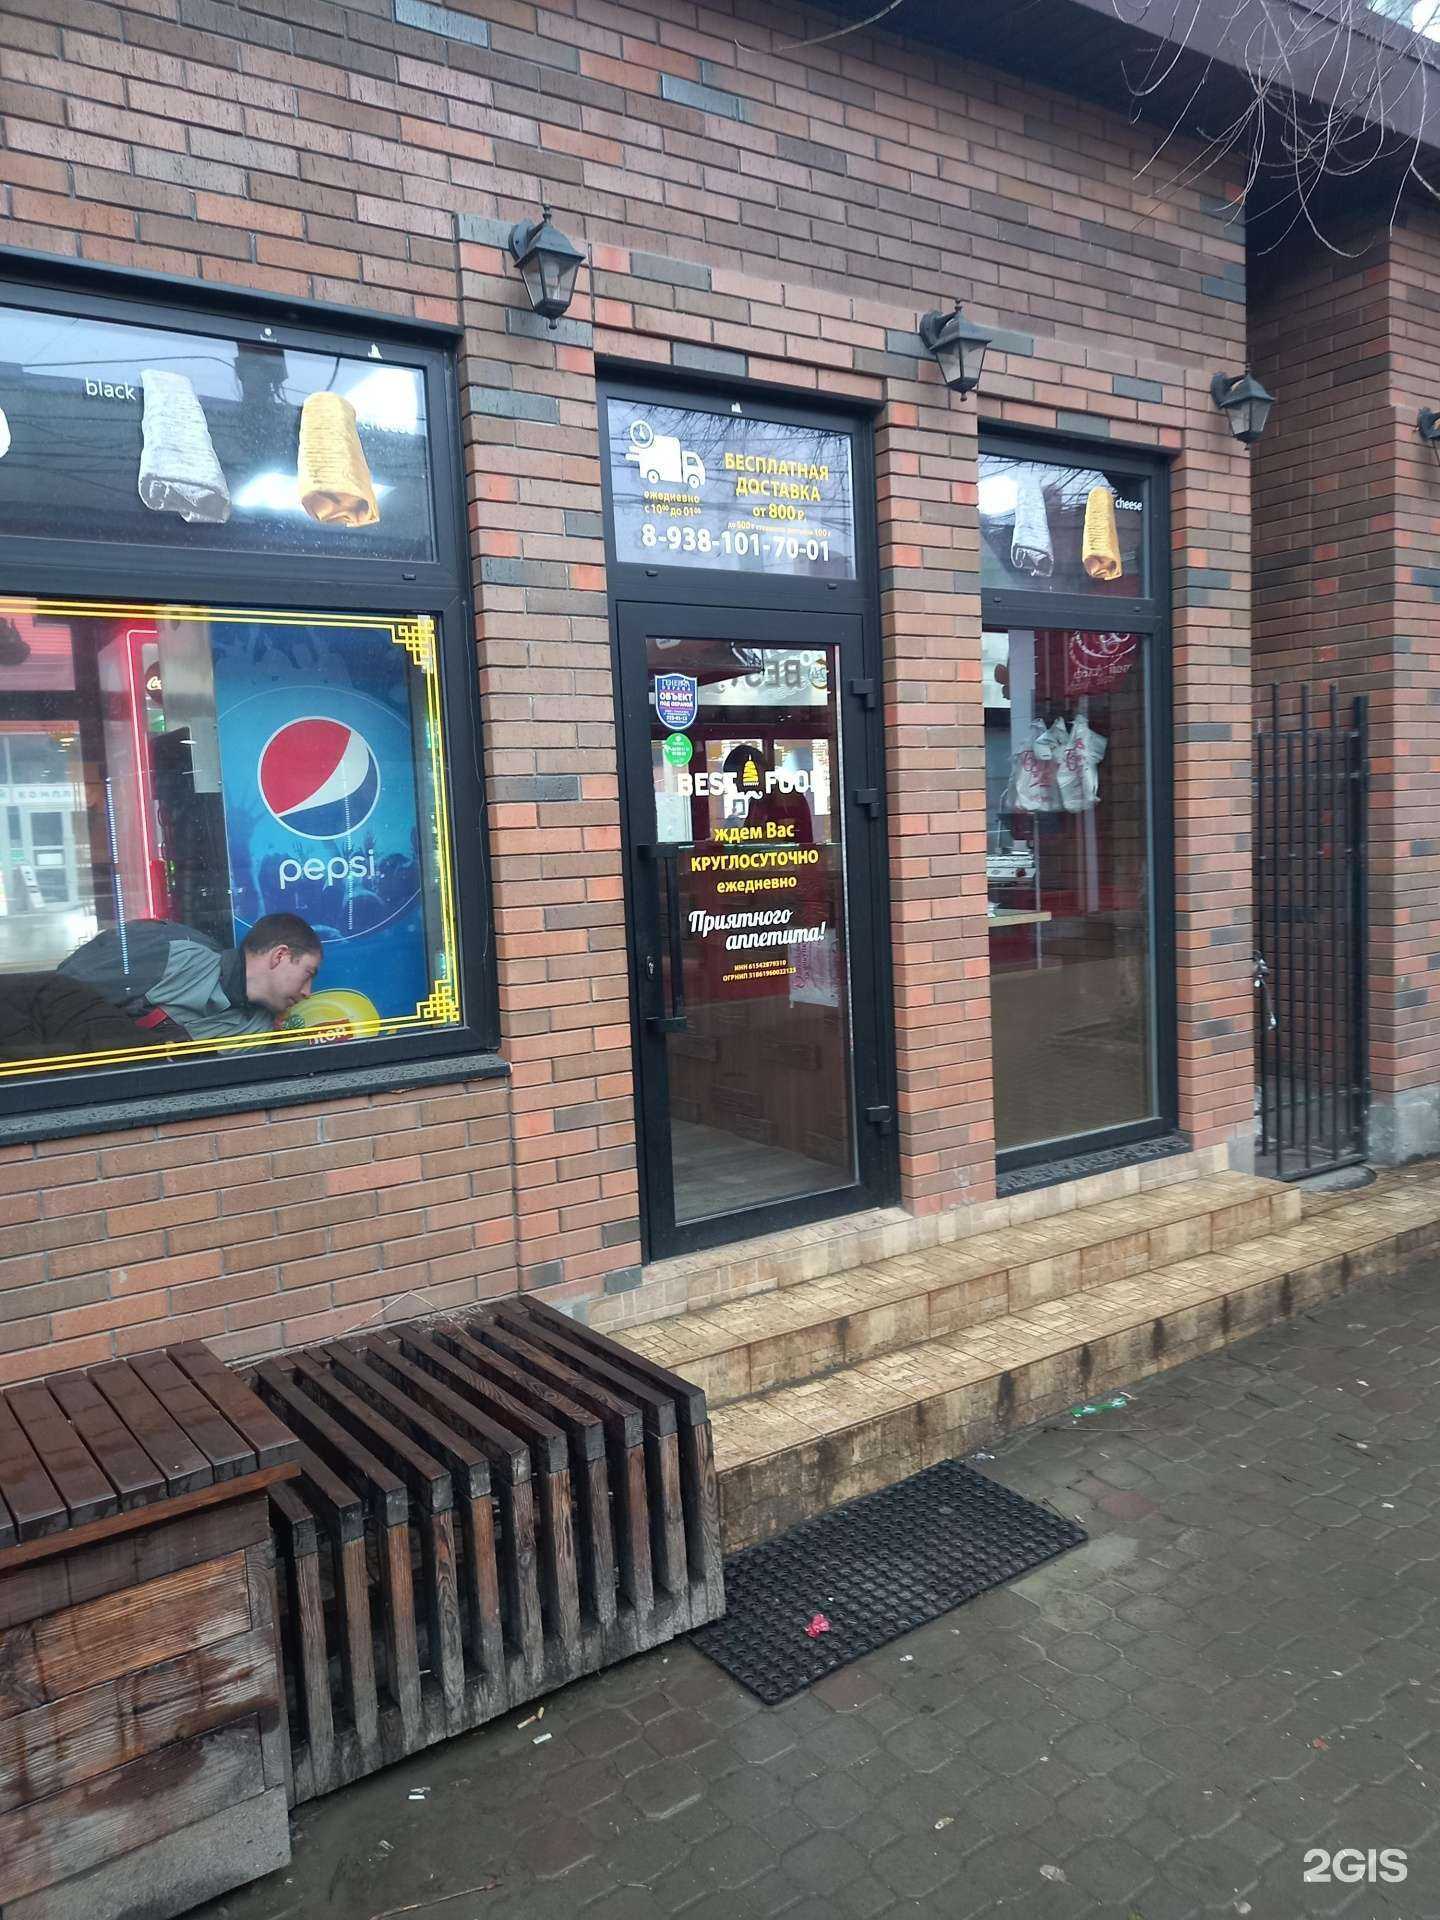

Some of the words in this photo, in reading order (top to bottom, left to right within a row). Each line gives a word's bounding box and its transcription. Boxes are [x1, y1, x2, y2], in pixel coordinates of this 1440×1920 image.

[85, 377, 136, 400] black
[725, 453, 829, 480] БЕСПЛАТНАЯ
[644, 490, 700, 504] ежедневно
[735, 476, 821, 502] ДОСТАВКА
[752, 506, 766, 517] от
[769, 503, 796, 520] 800
[1115, 497, 1142, 511] cheese
[641, 524, 829, 561] 8-938-101-70-01
[659, 692, 693, 702] ОБЪЕКТ
[677, 771, 738, 797] BEST
[715, 825, 762, 844] ждем
[766, 822, 795, 839] Вас
[279, 849, 376, 890] pepsi
[690, 849, 819, 872] КРУГЛОСУТОЧНО
[716, 877, 797, 894] ежедневно
[688, 908, 794, 939] Приятного
[725, 922, 827, 951] аппетита!
